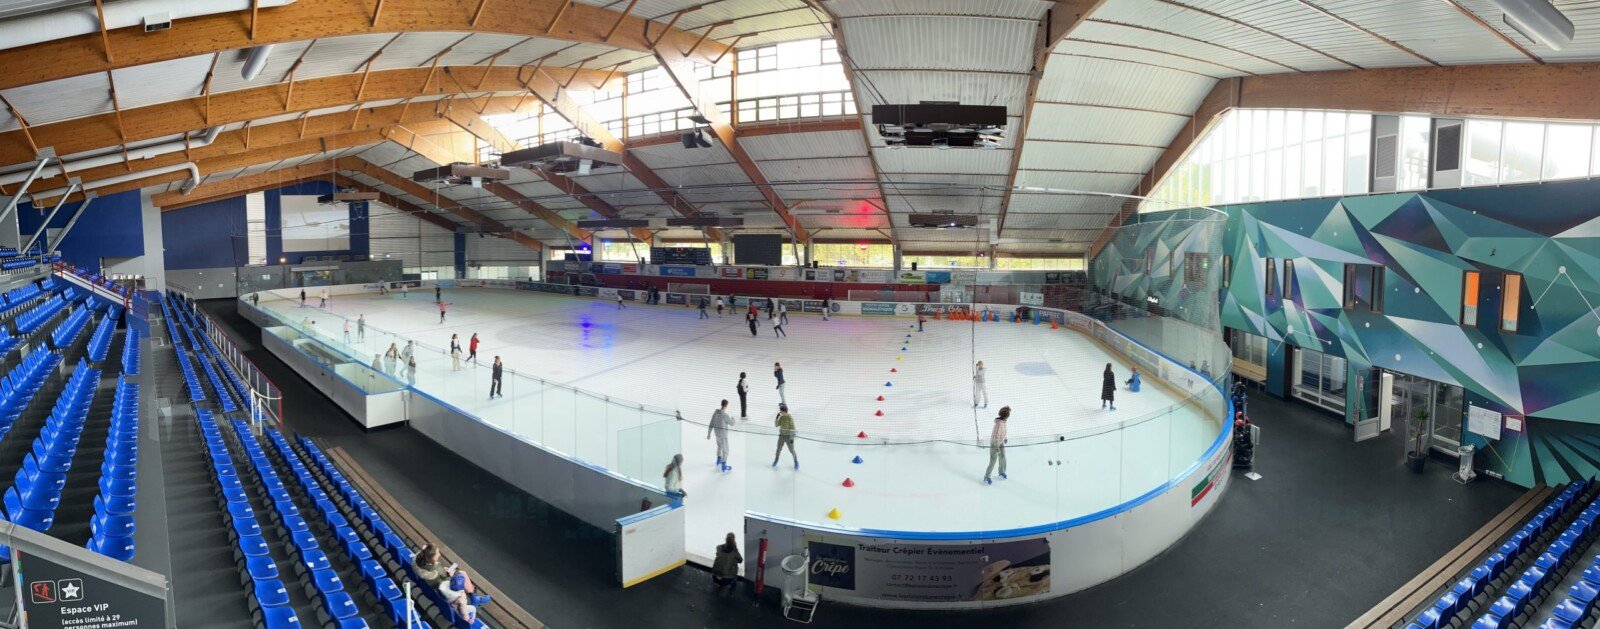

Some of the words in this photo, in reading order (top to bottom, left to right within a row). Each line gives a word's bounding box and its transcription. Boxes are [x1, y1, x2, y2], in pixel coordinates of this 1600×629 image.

[858, 543, 890, 554] Traiteur
[917, 574, 927, 582] 17
[60, 606, 92, 615] Espace
[93, 603, 109, 612] VIP
[85, 615, 105, 623] limité
[101, 618, 138, 627] maximum)
